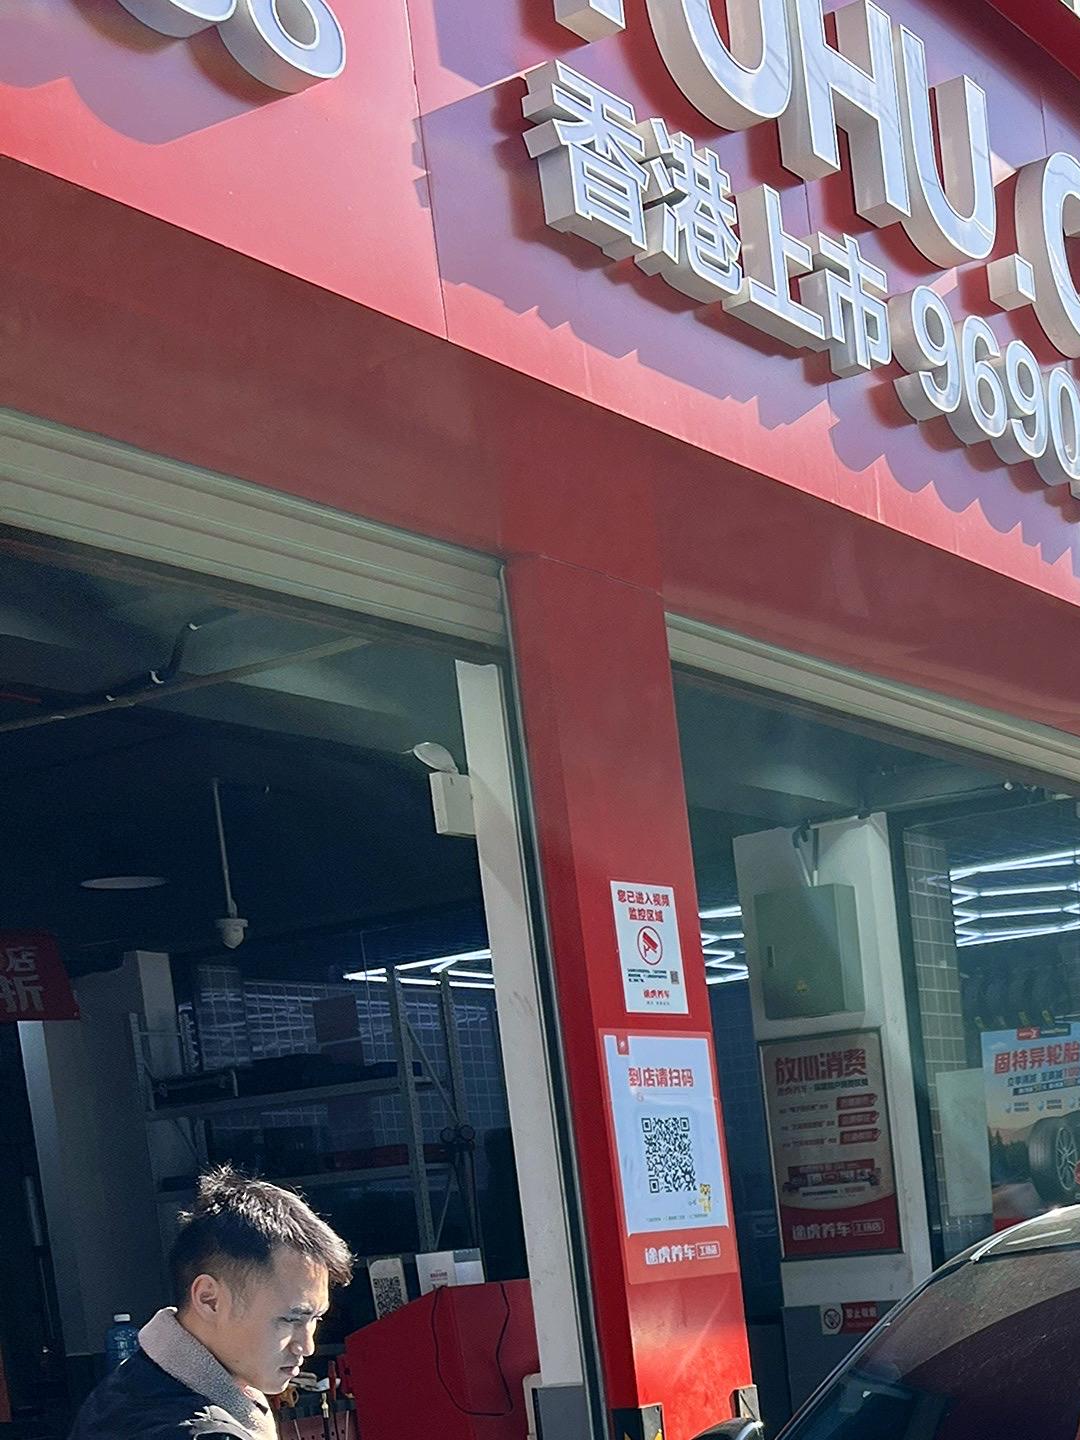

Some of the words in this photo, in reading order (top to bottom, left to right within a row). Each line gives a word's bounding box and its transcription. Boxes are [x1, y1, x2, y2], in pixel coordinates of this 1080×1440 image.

[525, 60, 892, 378] 香港上市
[628, 907, 664, 923] 监控区域
[775, 1048, 866, 1087] 放心消费
[994, 1040, 1080, 1075] 固特异轮胎
[628, 1067, 694, 1088] 到店请扫码
[792, 1221, 851, 1241] 途虎养车
[644, 1243, 696, 1265] 途虎养车
